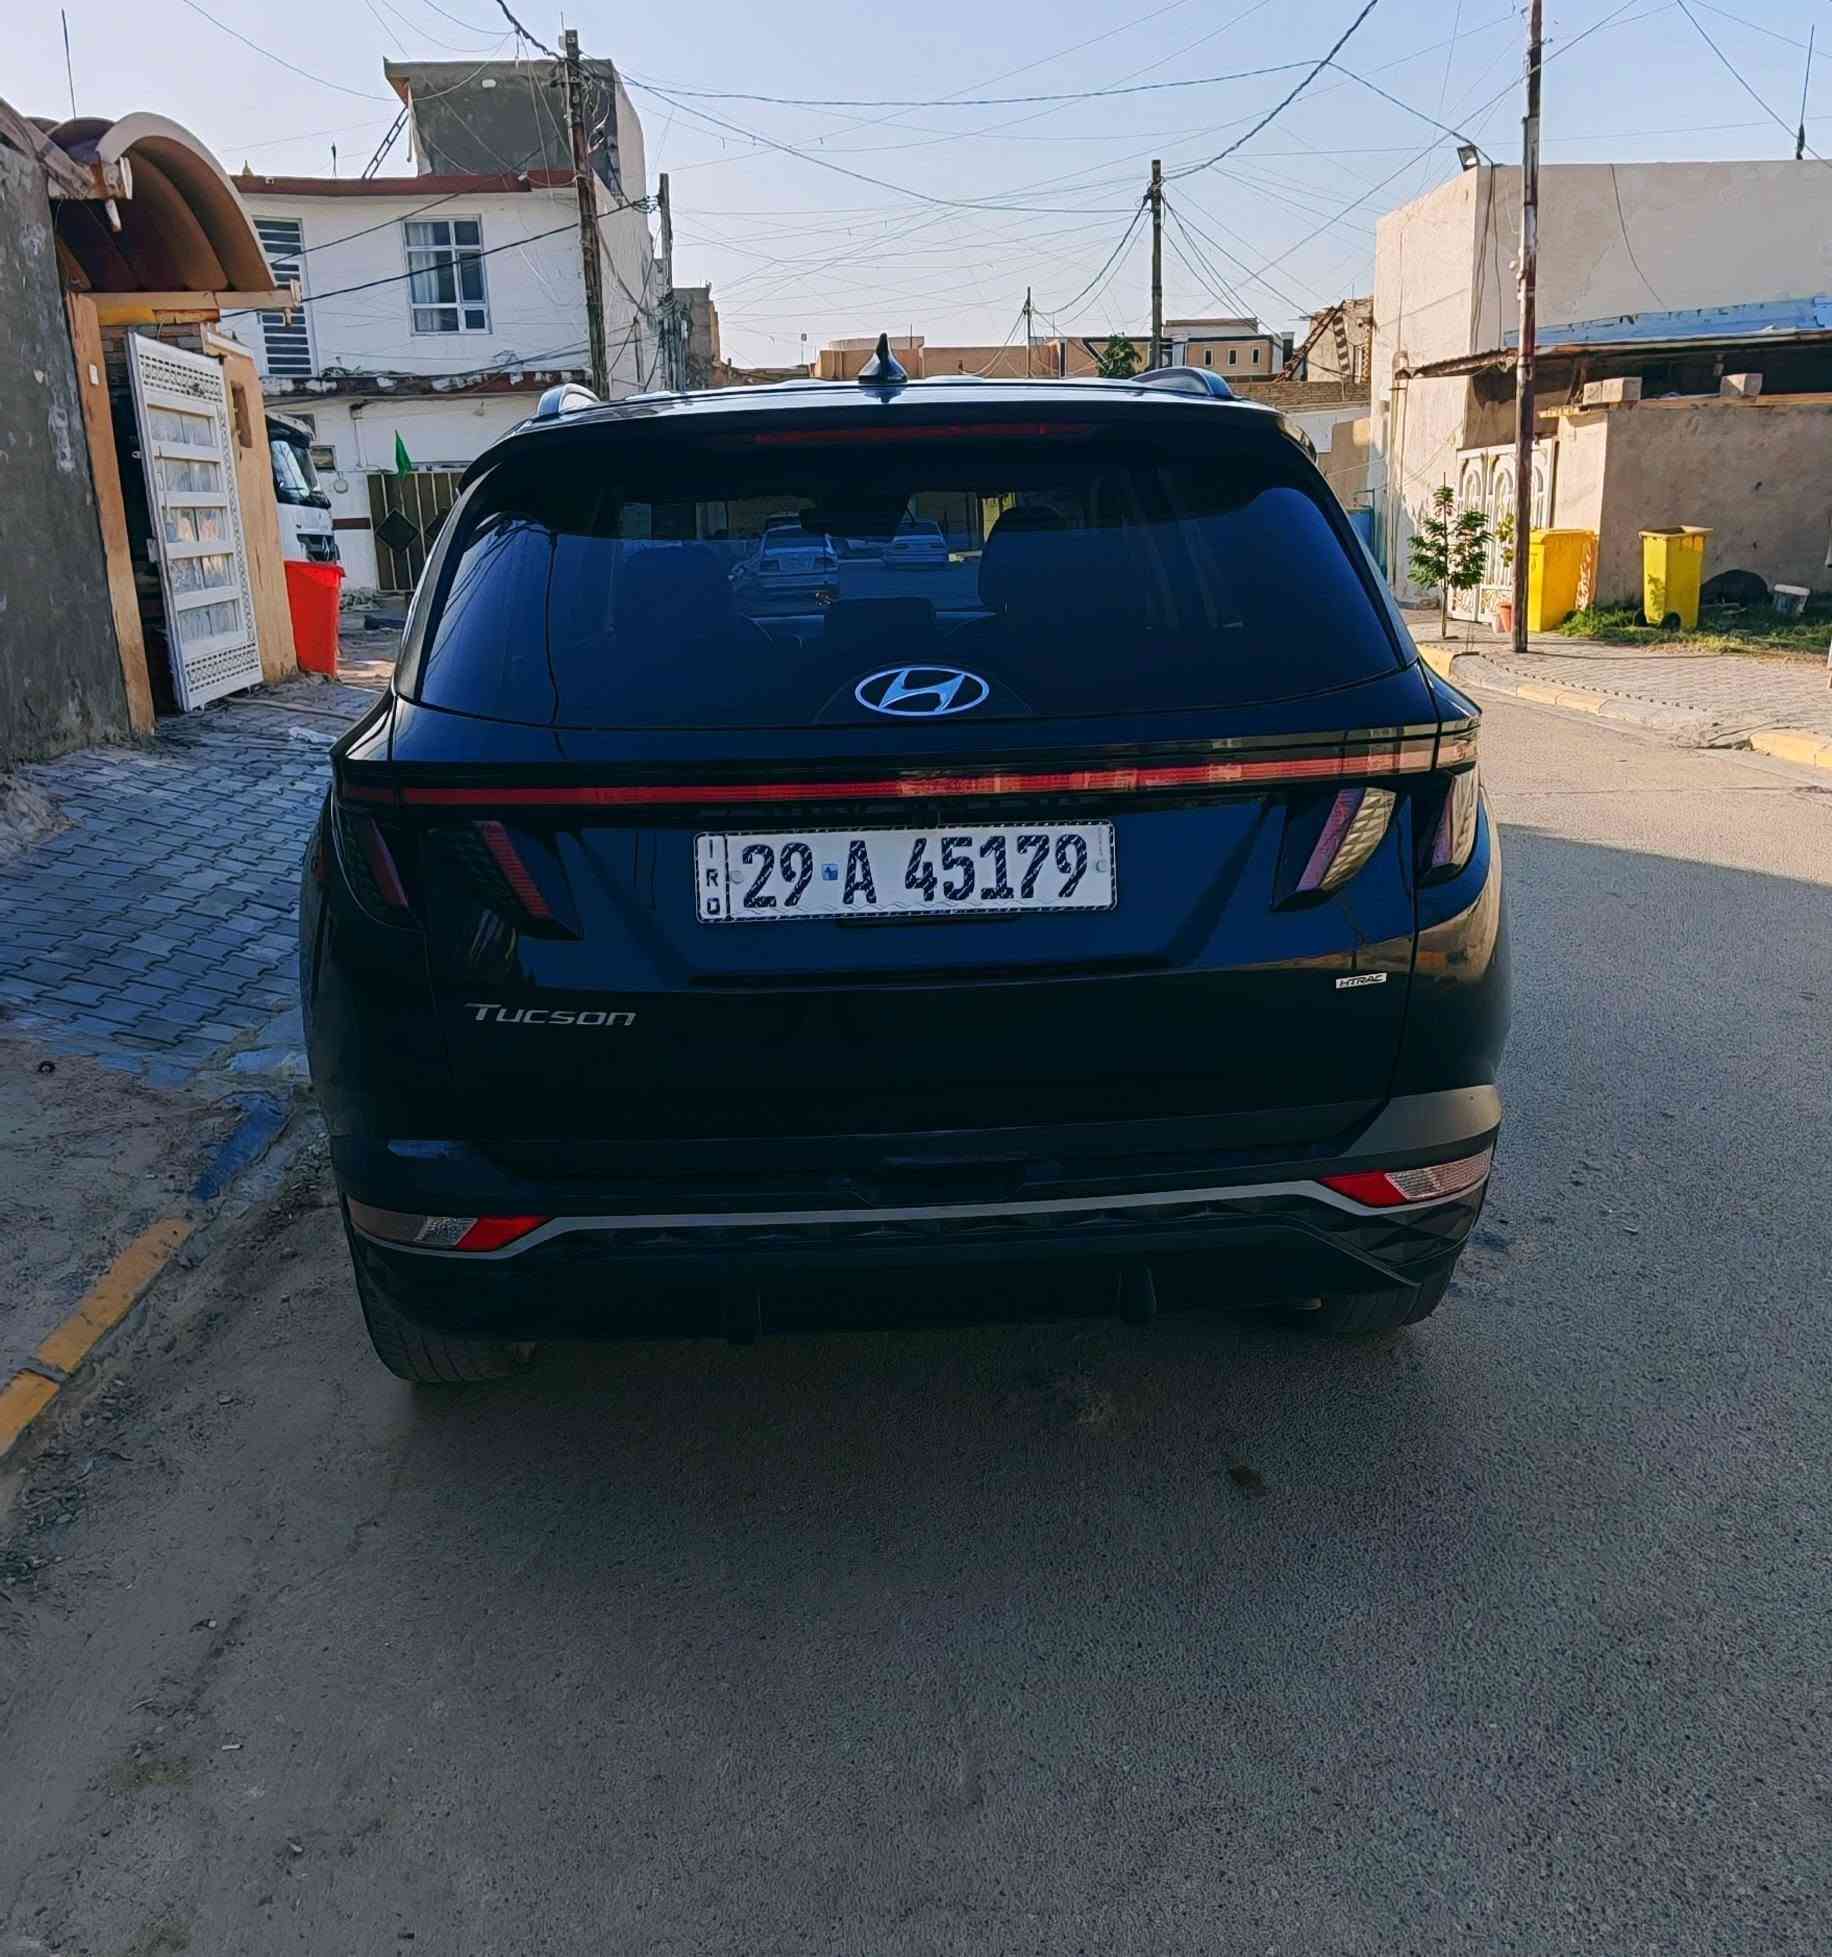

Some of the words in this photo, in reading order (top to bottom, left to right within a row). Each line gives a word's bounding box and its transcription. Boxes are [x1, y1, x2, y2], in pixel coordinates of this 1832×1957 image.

[742, 842, 814, 908] 29
[843, 839, 877, 904] A
[904, 833, 1088, 901] 45179
